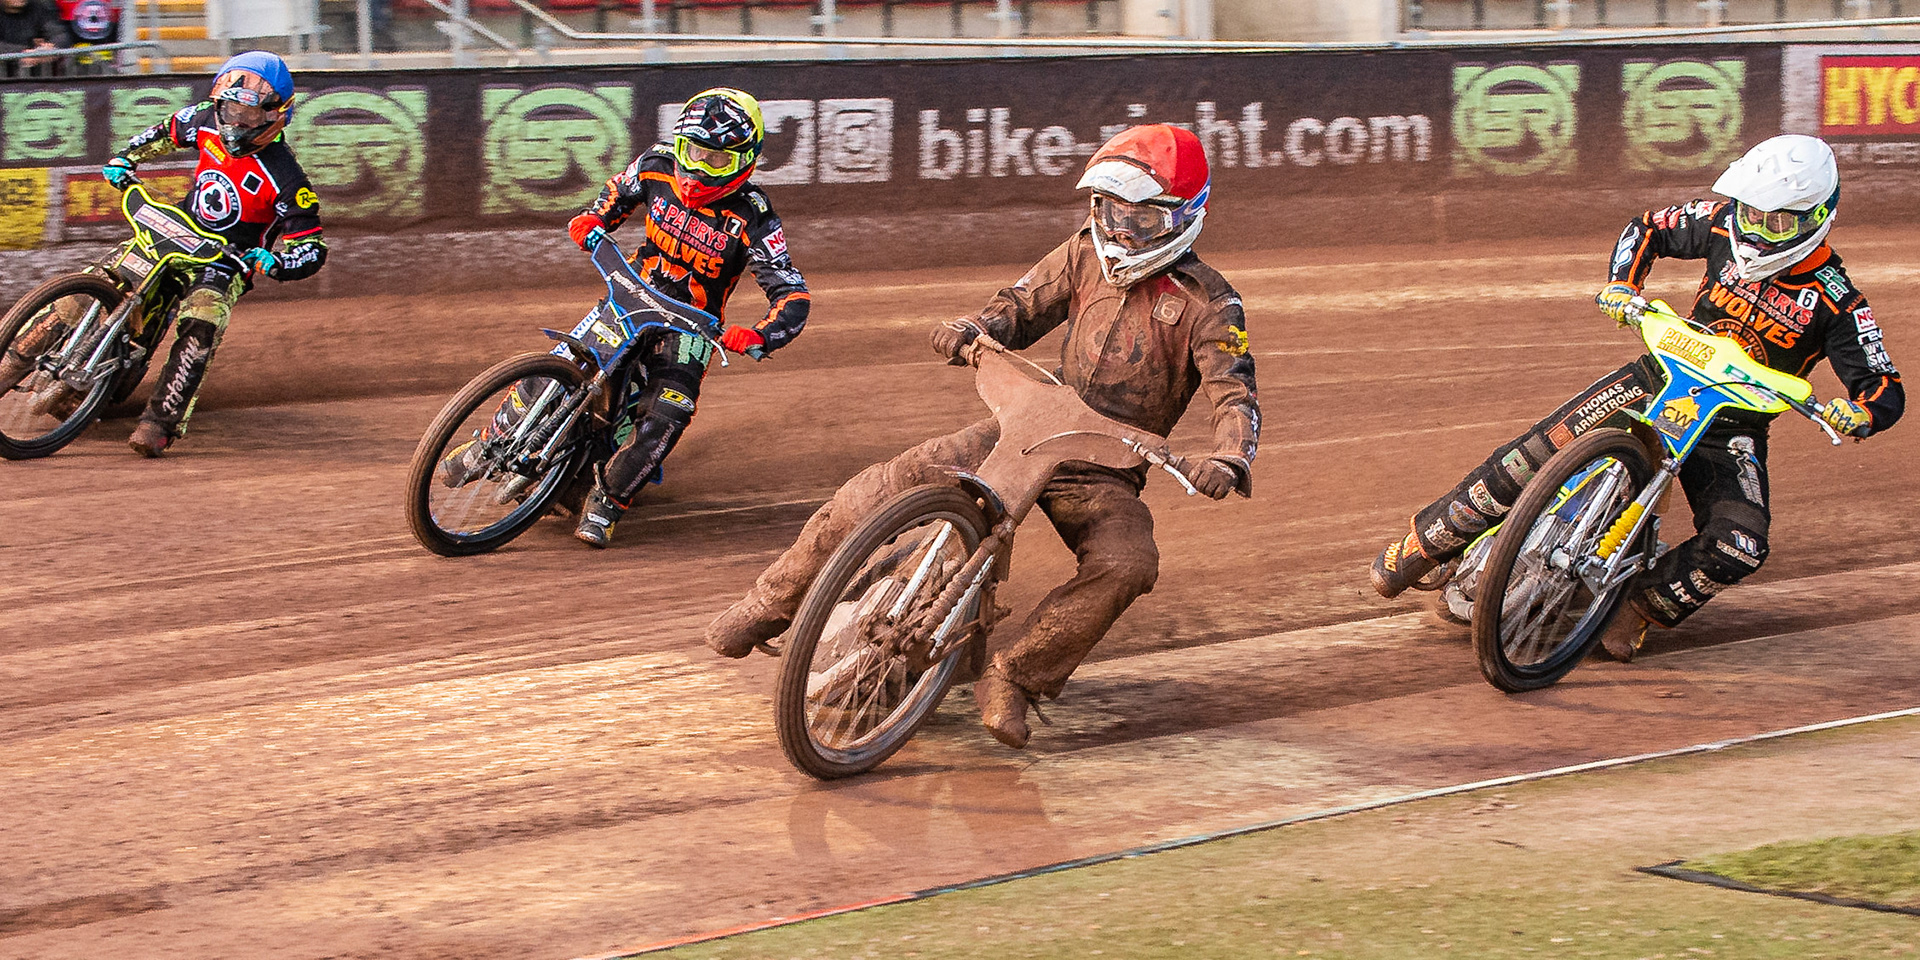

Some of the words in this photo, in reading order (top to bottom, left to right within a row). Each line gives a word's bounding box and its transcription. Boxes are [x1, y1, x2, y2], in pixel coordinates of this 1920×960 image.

[664, 204, 729, 251] PARRYS
[730, 218, 742, 235] 7
[646, 213, 725, 279] WOLVES
[1160, 300, 1176, 319] 6
[1709, 281, 1801, 349] WOLVES
[1802, 290, 1815, 308] 6
[1660, 327, 1716, 363] PARRYS
[1573, 385, 1644, 436] ARMSTRONG
[1575, 383, 1625, 418] THOMAS
